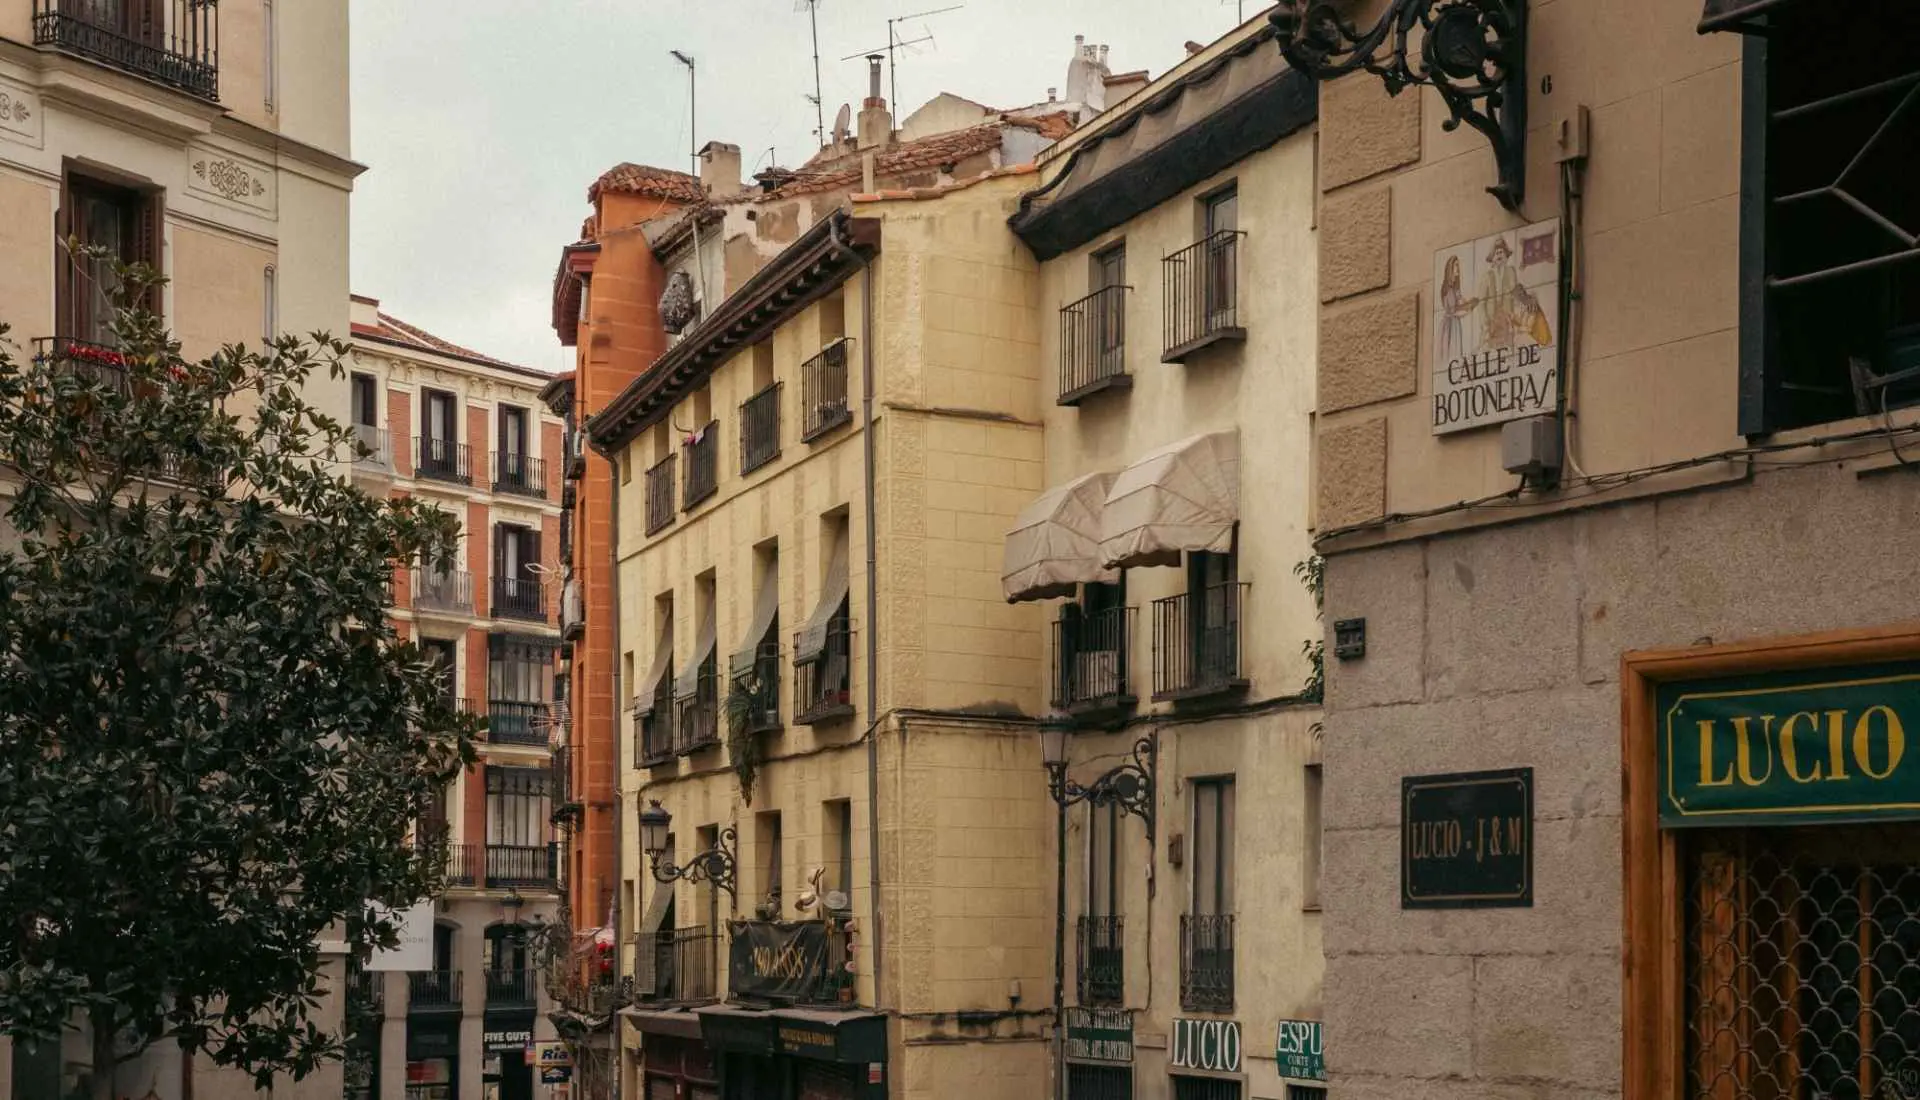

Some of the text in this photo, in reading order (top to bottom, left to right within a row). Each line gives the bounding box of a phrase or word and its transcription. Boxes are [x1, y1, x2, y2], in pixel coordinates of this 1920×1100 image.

[1541, 74, 1552, 95] 6
[1448, 344, 1541, 386] CALLE DE
[1435, 369, 1555, 426] BOTONERAS
[1696, 705, 1905, 787] LUCIO
[1411, 819, 1462, 860] LUCIO
[484, 1031, 531, 1042] FIVE GUYS
[541, 1045, 569, 1060] Ria
[1172, 1018, 1240, 1072] LUCIO
